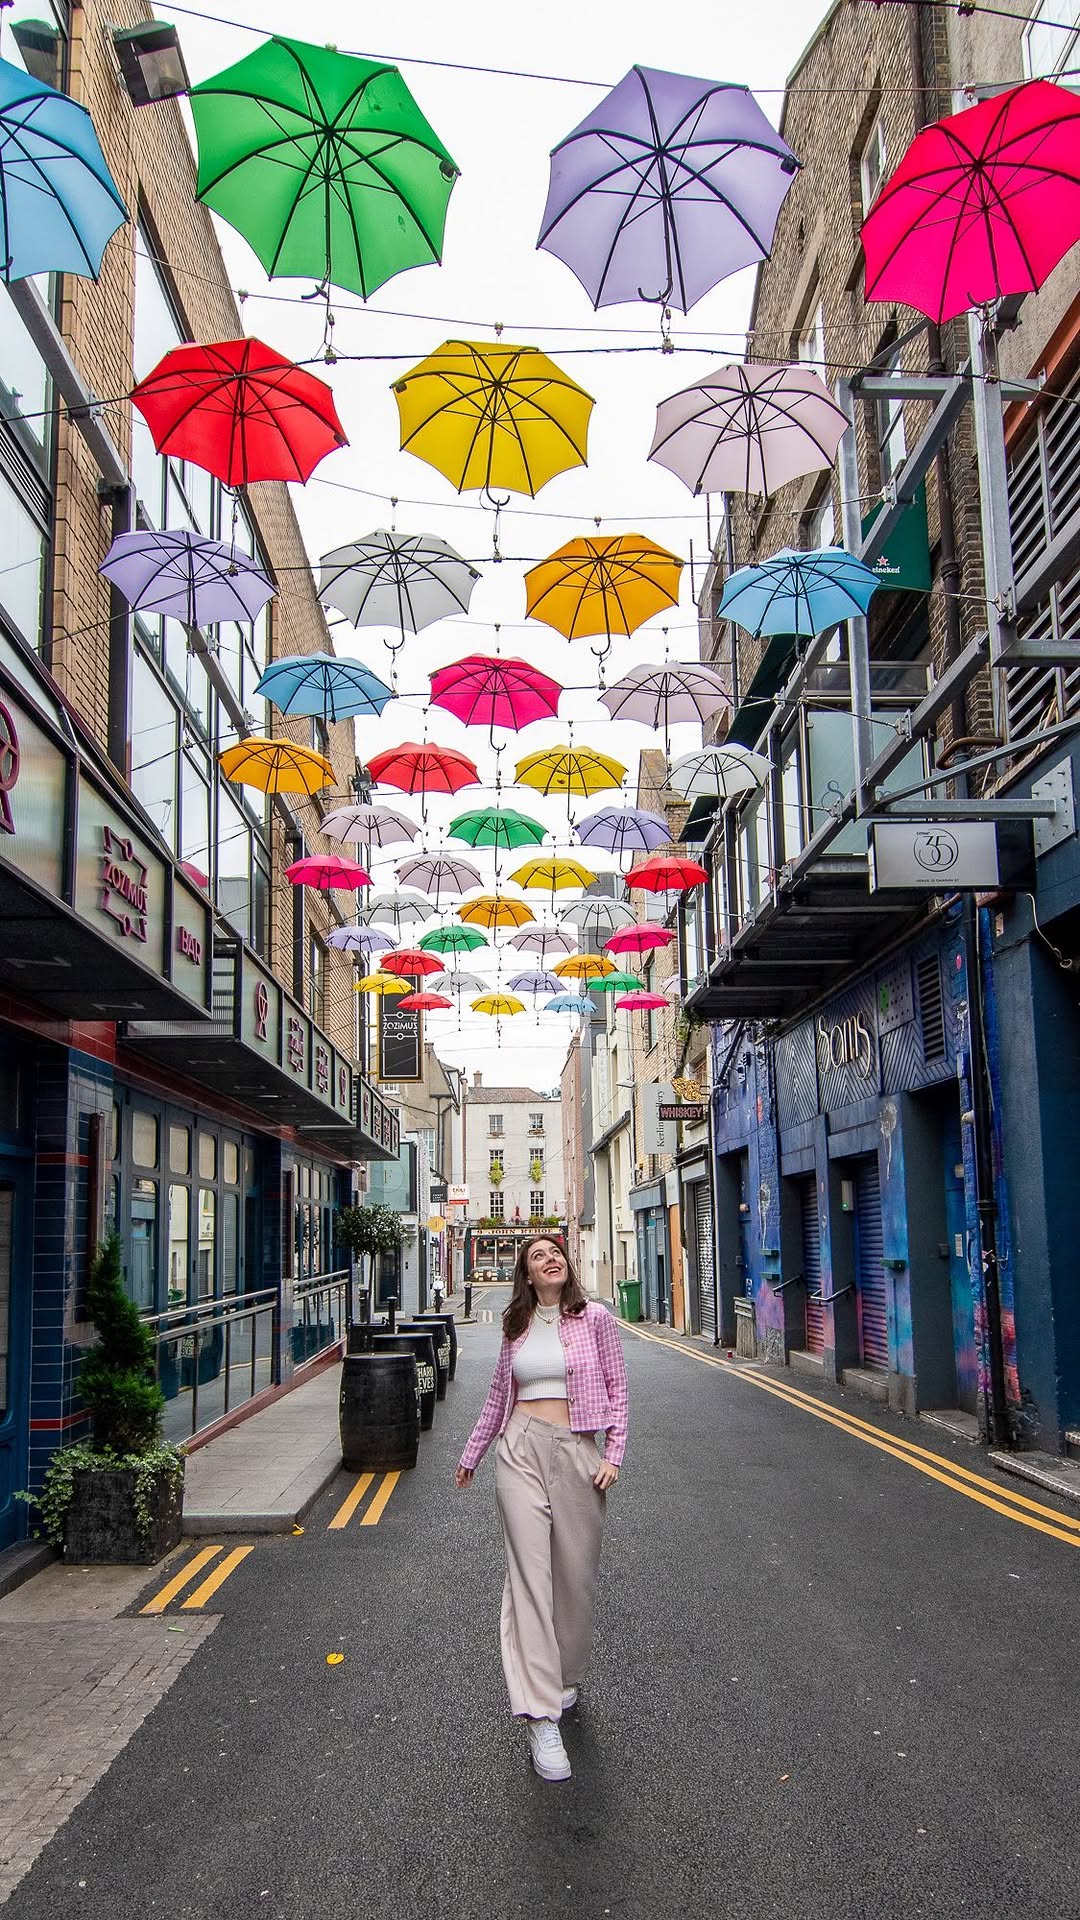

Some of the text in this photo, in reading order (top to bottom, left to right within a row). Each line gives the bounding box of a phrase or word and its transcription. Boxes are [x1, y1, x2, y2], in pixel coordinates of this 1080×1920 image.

[872, 566, 900, 574] eineken
[919, 836, 954, 866] 35
[179, 926, 201, 966] BAR
[660, 1107, 702, 1118] WHISKEY
[656, 1121, 665, 1147] Kerlin
[417, 1366, 434, 1378] HARD
[418, 1376, 435, 1390] EVES
